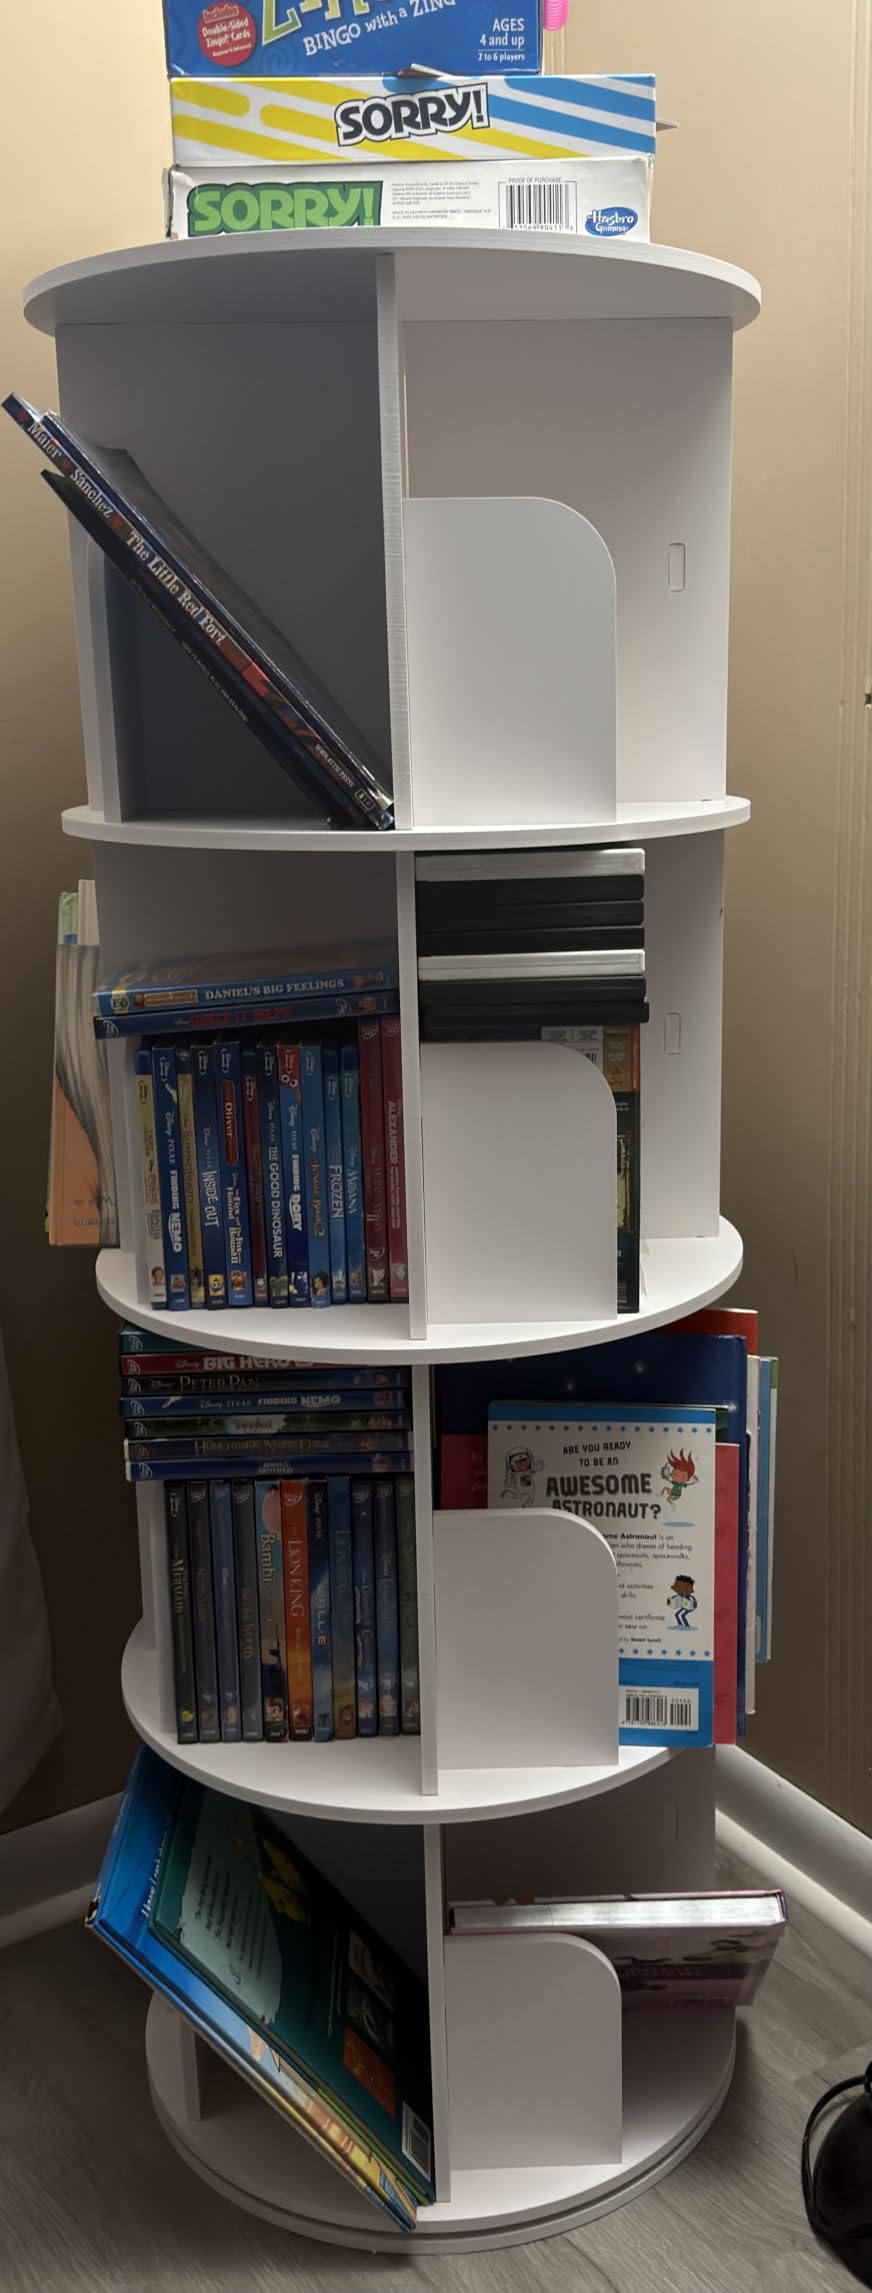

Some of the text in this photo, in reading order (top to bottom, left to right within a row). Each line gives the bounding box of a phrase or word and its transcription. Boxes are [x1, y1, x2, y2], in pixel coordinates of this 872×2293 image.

[302, 22, 361, 57] BINGO
[364, 11, 398, 33] with
[399, 8, 408, 18] a
[479, 33, 525, 49] 4 and up
[492, 18, 525, 32] AGES
[477, 51, 525, 63] 2 to 6 players
[338, 88, 486, 143] SORRY!
[193, 186, 376, 233] SORRY!
[590, 209, 635, 226] Hasbro
[27, 422, 62, 459] Maier
[126, 530, 149, 562] The
[147, 554, 181, 595] Little
[176, 590, 204, 619] Red
[198, 612, 227, 646] Fort
[205, 986, 262, 1001] DANIEL'S
[263, 984, 285, 995] BIG
[286, 978, 345, 993] FEELINGS
[224, 1101, 234, 1138] Oliver
[388, 1101, 399, 1165] ALEXANDER
[269, 1146, 278, 1161] THE
[170, 1170, 180, 1209] FINDING
[202, 1170, 218, 1204] INSIDE
[270, 1163, 280, 1199] GOOD
[291, 1154, 301, 1191] FINDING
[227, 1186, 235, 1220] Hound
[329, 1164, 344, 1218] FROZEN
[204, 1205, 219, 1228] OUT
[271, 1201, 283, 1258] DINOSAUR
[289, 1193, 303, 1232] DORY
[168, 1212, 182, 1253] NEMO
[203, 1356, 235, 1370] BIG
[179, 1375, 225, 1392] PETER
[228, 1374, 259, 1391] PAN
[257, 1396, 298, 1406] FINDING
[300, 1394, 342, 1408] NEMO
[563, 1440, 631, 1455] ARE YOU READY
[579, 1458, 589, 1467] TO
[593, 1457, 604, 1466] BE
[545, 1472, 652, 1498] AWESOME
[261, 1534, 277, 1584] Bambi
[288, 1540, 304, 1574] LION
[289, 1575, 305, 1617] KING
